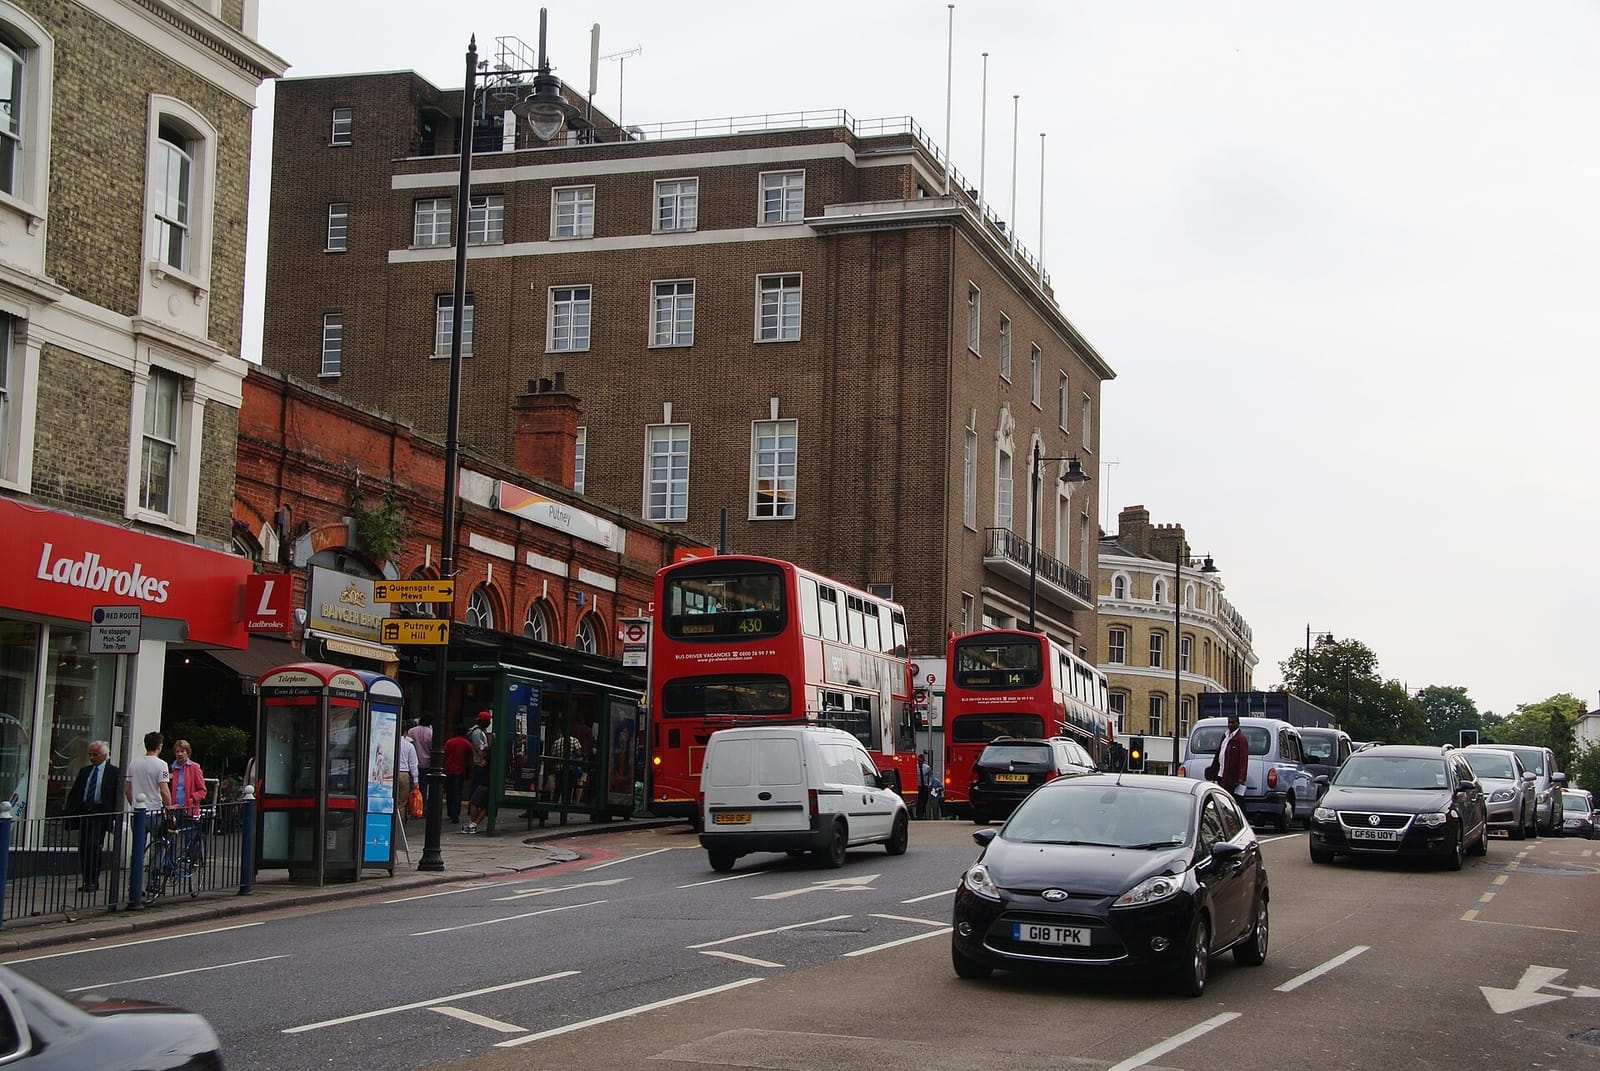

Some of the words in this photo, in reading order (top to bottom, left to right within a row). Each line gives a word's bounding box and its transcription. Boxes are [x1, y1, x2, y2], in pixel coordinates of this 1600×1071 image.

[549, 505, 571, 526] Putney
[37, 542, 170, 603] Ladbrokes
[389, 584, 435, 592] Queensgate
[257, 580, 277, 615] L
[321, 601, 360, 625] BANGER
[248, 620, 284, 628] Ladbrokes
[403, 621, 435, 631] Putney
[739, 618, 762, 633] 430
[410, 632, 426, 640] Hill
[278, 675, 308, 684] Telephone
[929, 675, 933, 683] E
[1008, 674, 1020, 683] 14
[1029, 926, 1051, 941] G18
[1054, 928, 1081, 943] TPK
